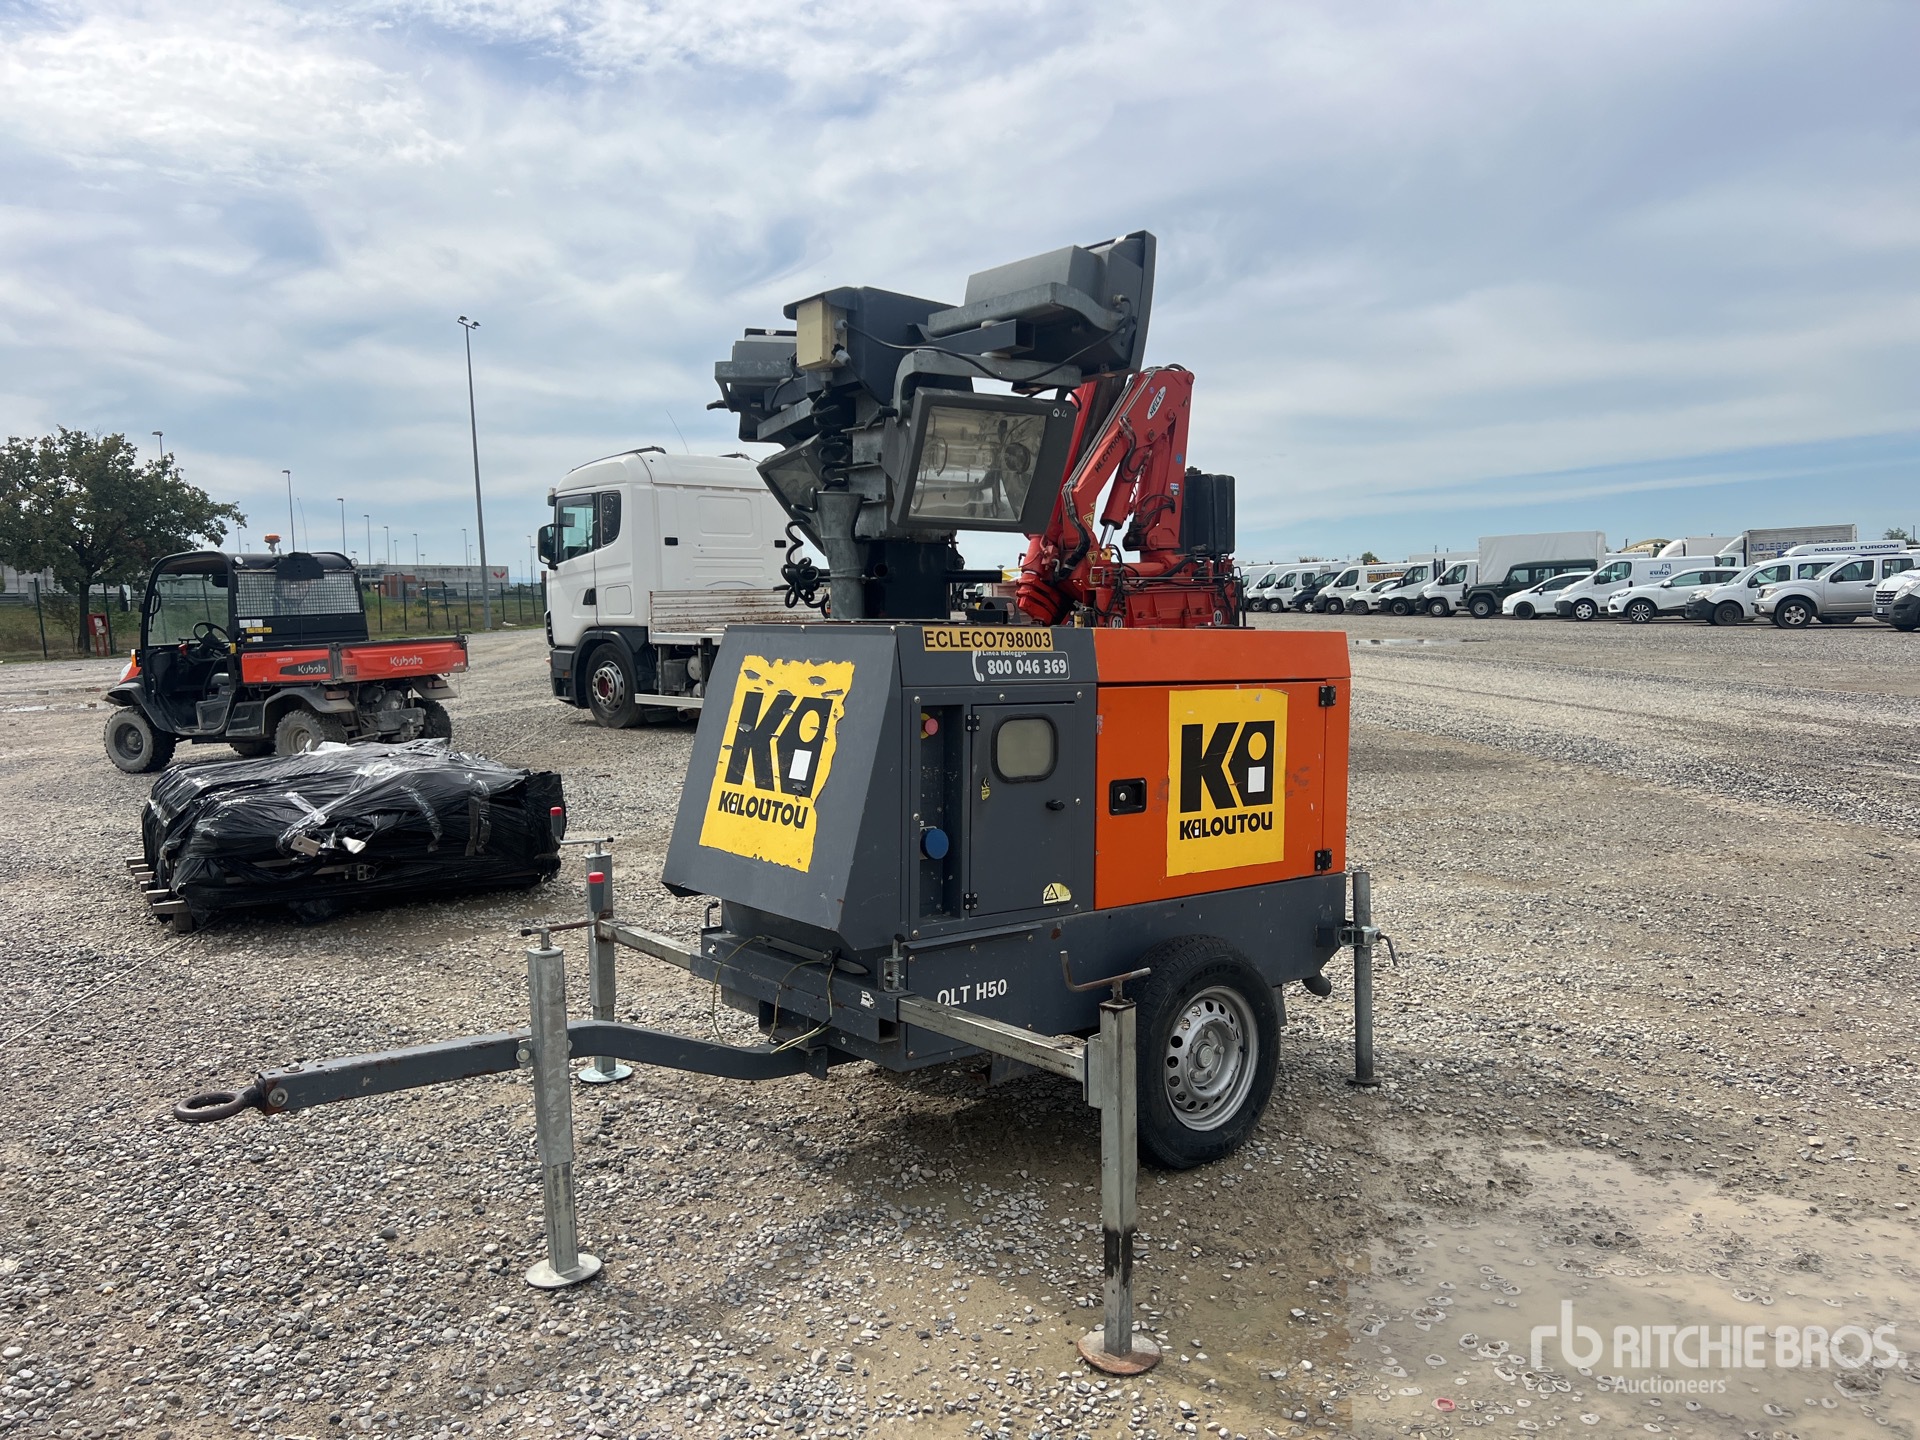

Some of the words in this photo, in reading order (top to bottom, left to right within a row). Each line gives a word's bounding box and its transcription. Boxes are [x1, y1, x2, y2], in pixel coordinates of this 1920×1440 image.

[923, 630, 1051, 648] ECLECO798003
[297, 664, 327, 674] Kubota
[390, 655, 423, 667] Kubota
[987, 659, 1012, 675] 800
[1015, 659, 1040, 675] 046
[1043, 659, 1067, 675] 369
[937, 985, 971, 1006] QLT
[976, 979, 1007, 1000] H50
